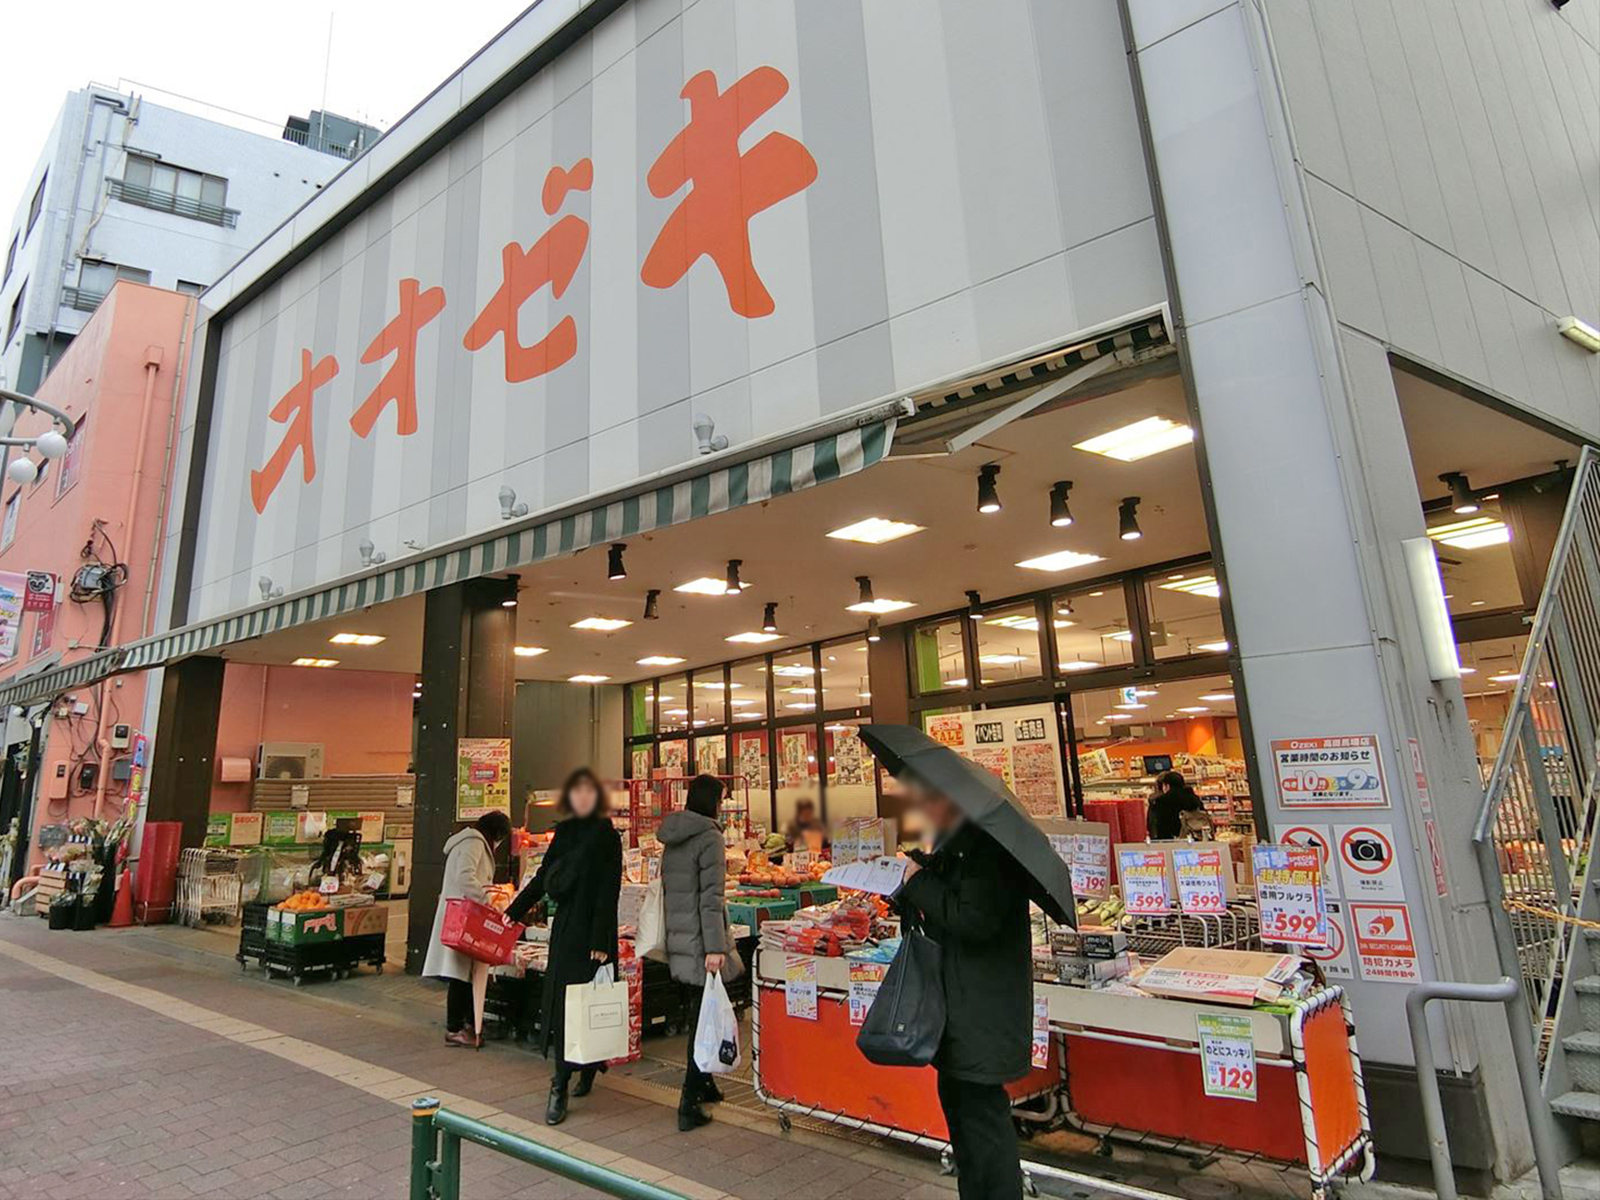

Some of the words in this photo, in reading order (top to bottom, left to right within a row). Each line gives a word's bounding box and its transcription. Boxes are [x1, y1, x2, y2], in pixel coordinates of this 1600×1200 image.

[251, 66, 817, 514] オオゼキ
[1290, 741, 1318, 749] OZEKI
[1280, 750, 1370, 763] 営業時間のお知らせ
[1086, 876, 1106, 890] 199
[1260, 890, 1313, 902] 徳用フルグラ
[1087, 936, 1108, 945] meiji
[1362, 957, 1413, 968] 防犯カメラ
[1365, 968, 1416, 978] 24時間作動中
[1206, 1045, 1251, 1059] のどにスッキリ
